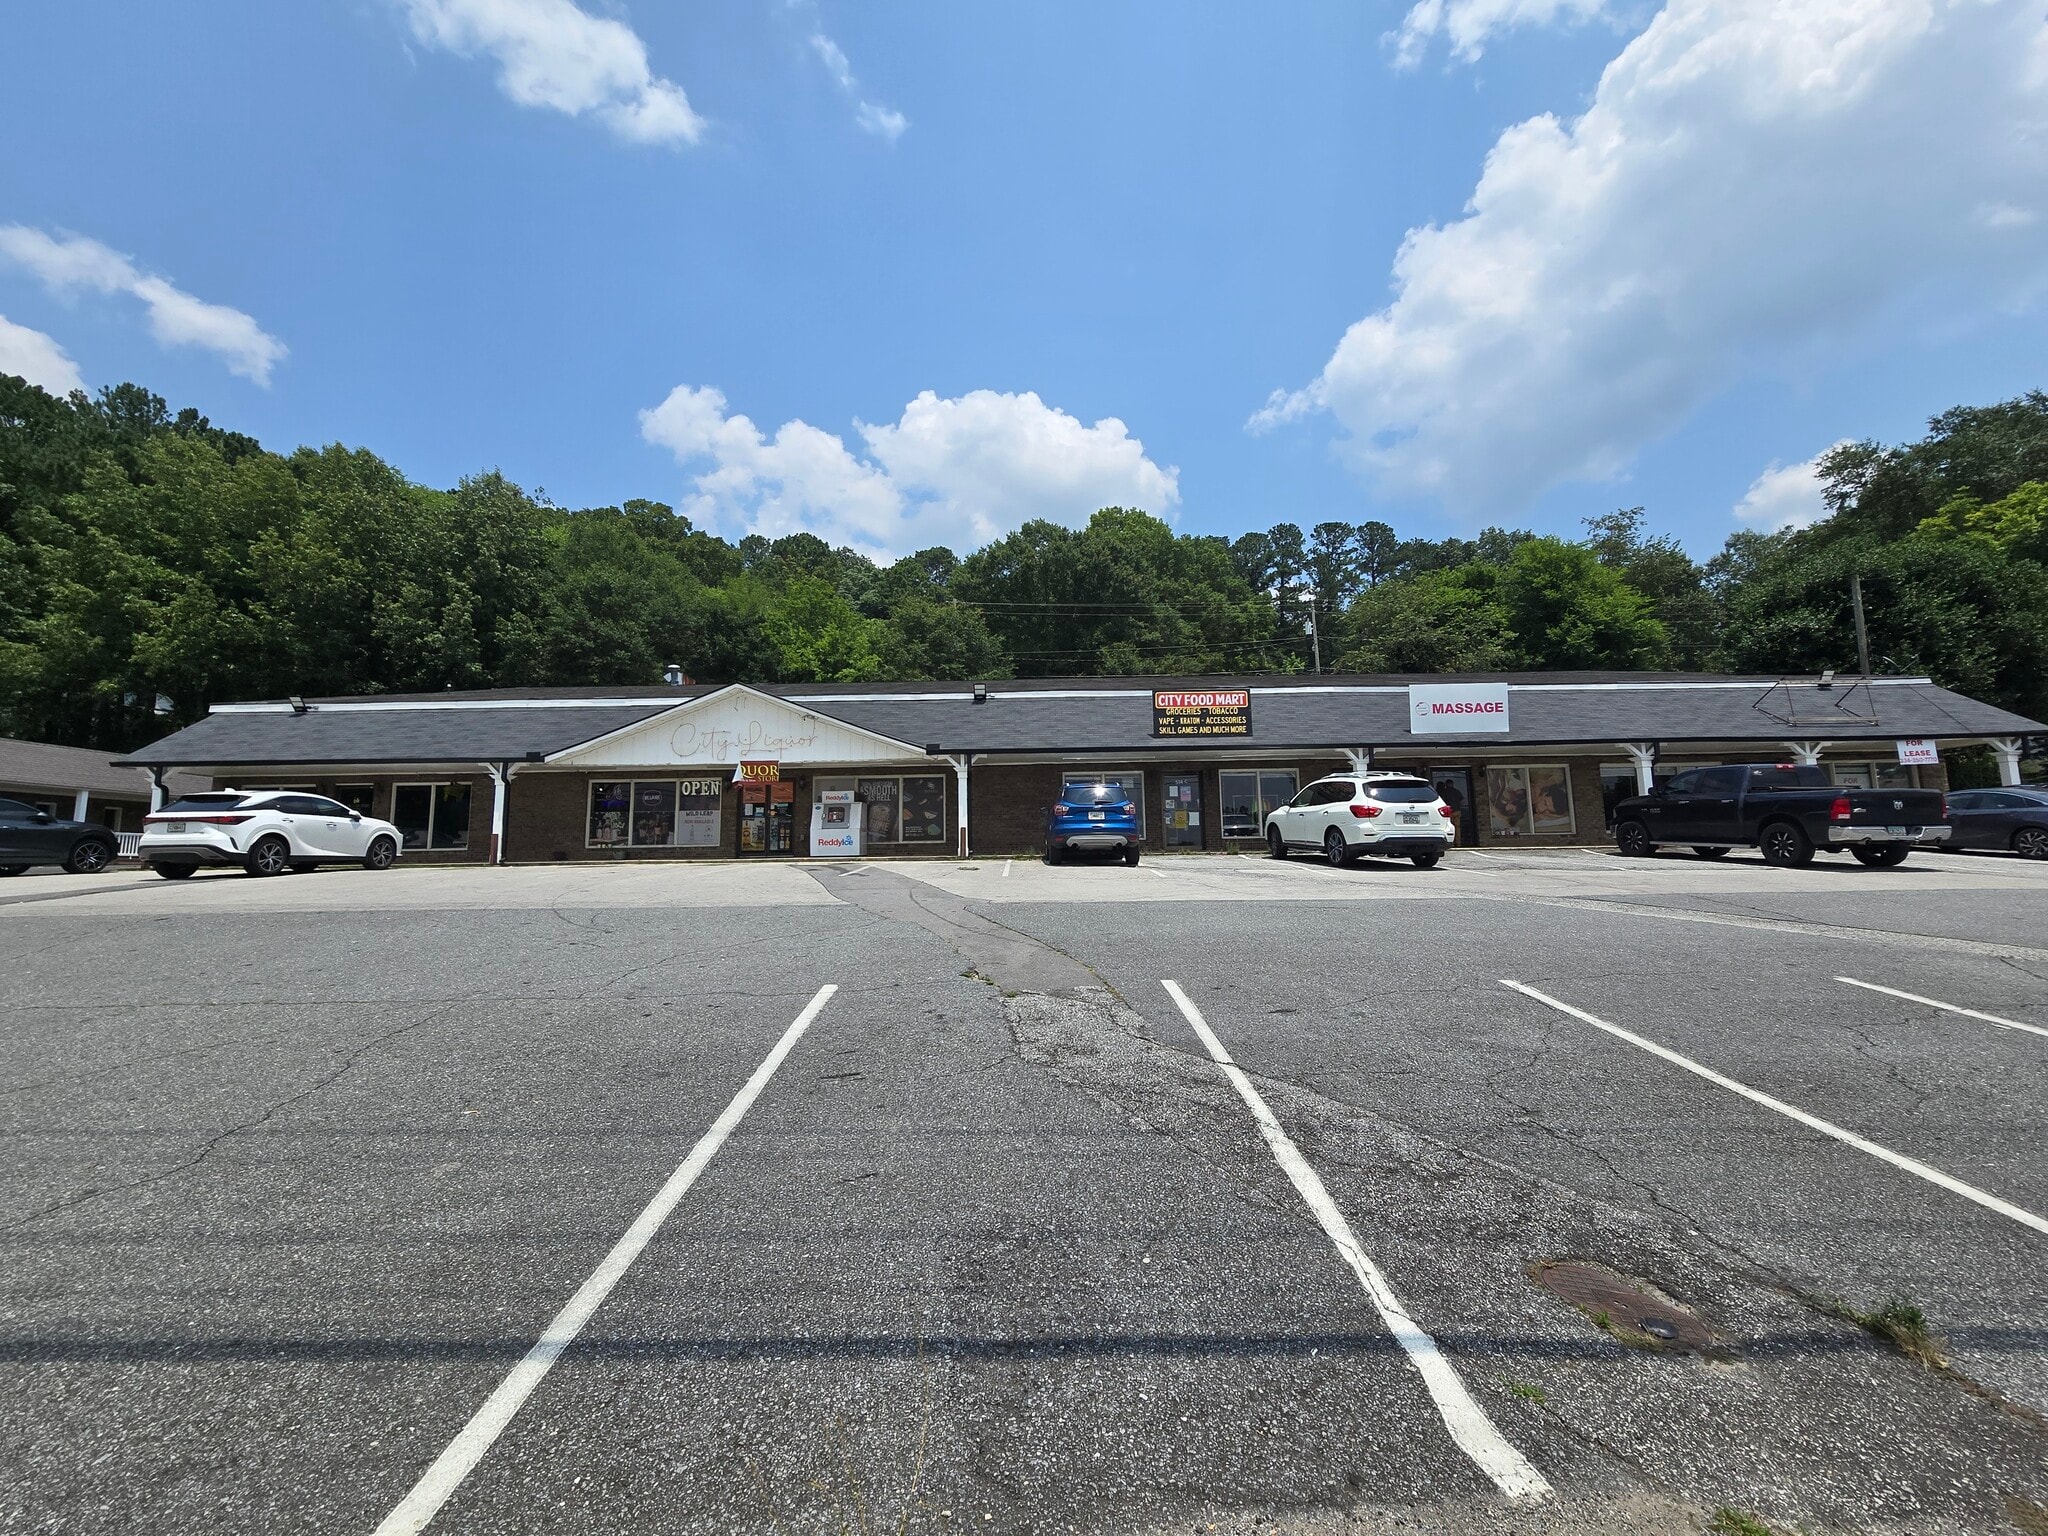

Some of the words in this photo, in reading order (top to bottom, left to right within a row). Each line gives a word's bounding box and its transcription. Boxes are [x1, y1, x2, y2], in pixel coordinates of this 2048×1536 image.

[1158, 694, 1183, 706] CITY
[1184, 694, 1212, 706] FOOD
[1215, 693, 1245, 705] MART
[1208, 707, 1239, 715] TOBACCO
[1432, 702, 1504, 714] MASSAGE
[1158, 717, 1175, 725] VAPE
[1205, 716, 1247, 724] ACCESSORIES
[1177, 726, 1198, 734] GAMES
[1212, 726, 1230, 734] MUCH
[671, 722, 732, 761] City
[738, 720, 819, 760] Liquor
[740, 765, 778, 778] QUOR
[681, 781, 719, 796] OPEN
